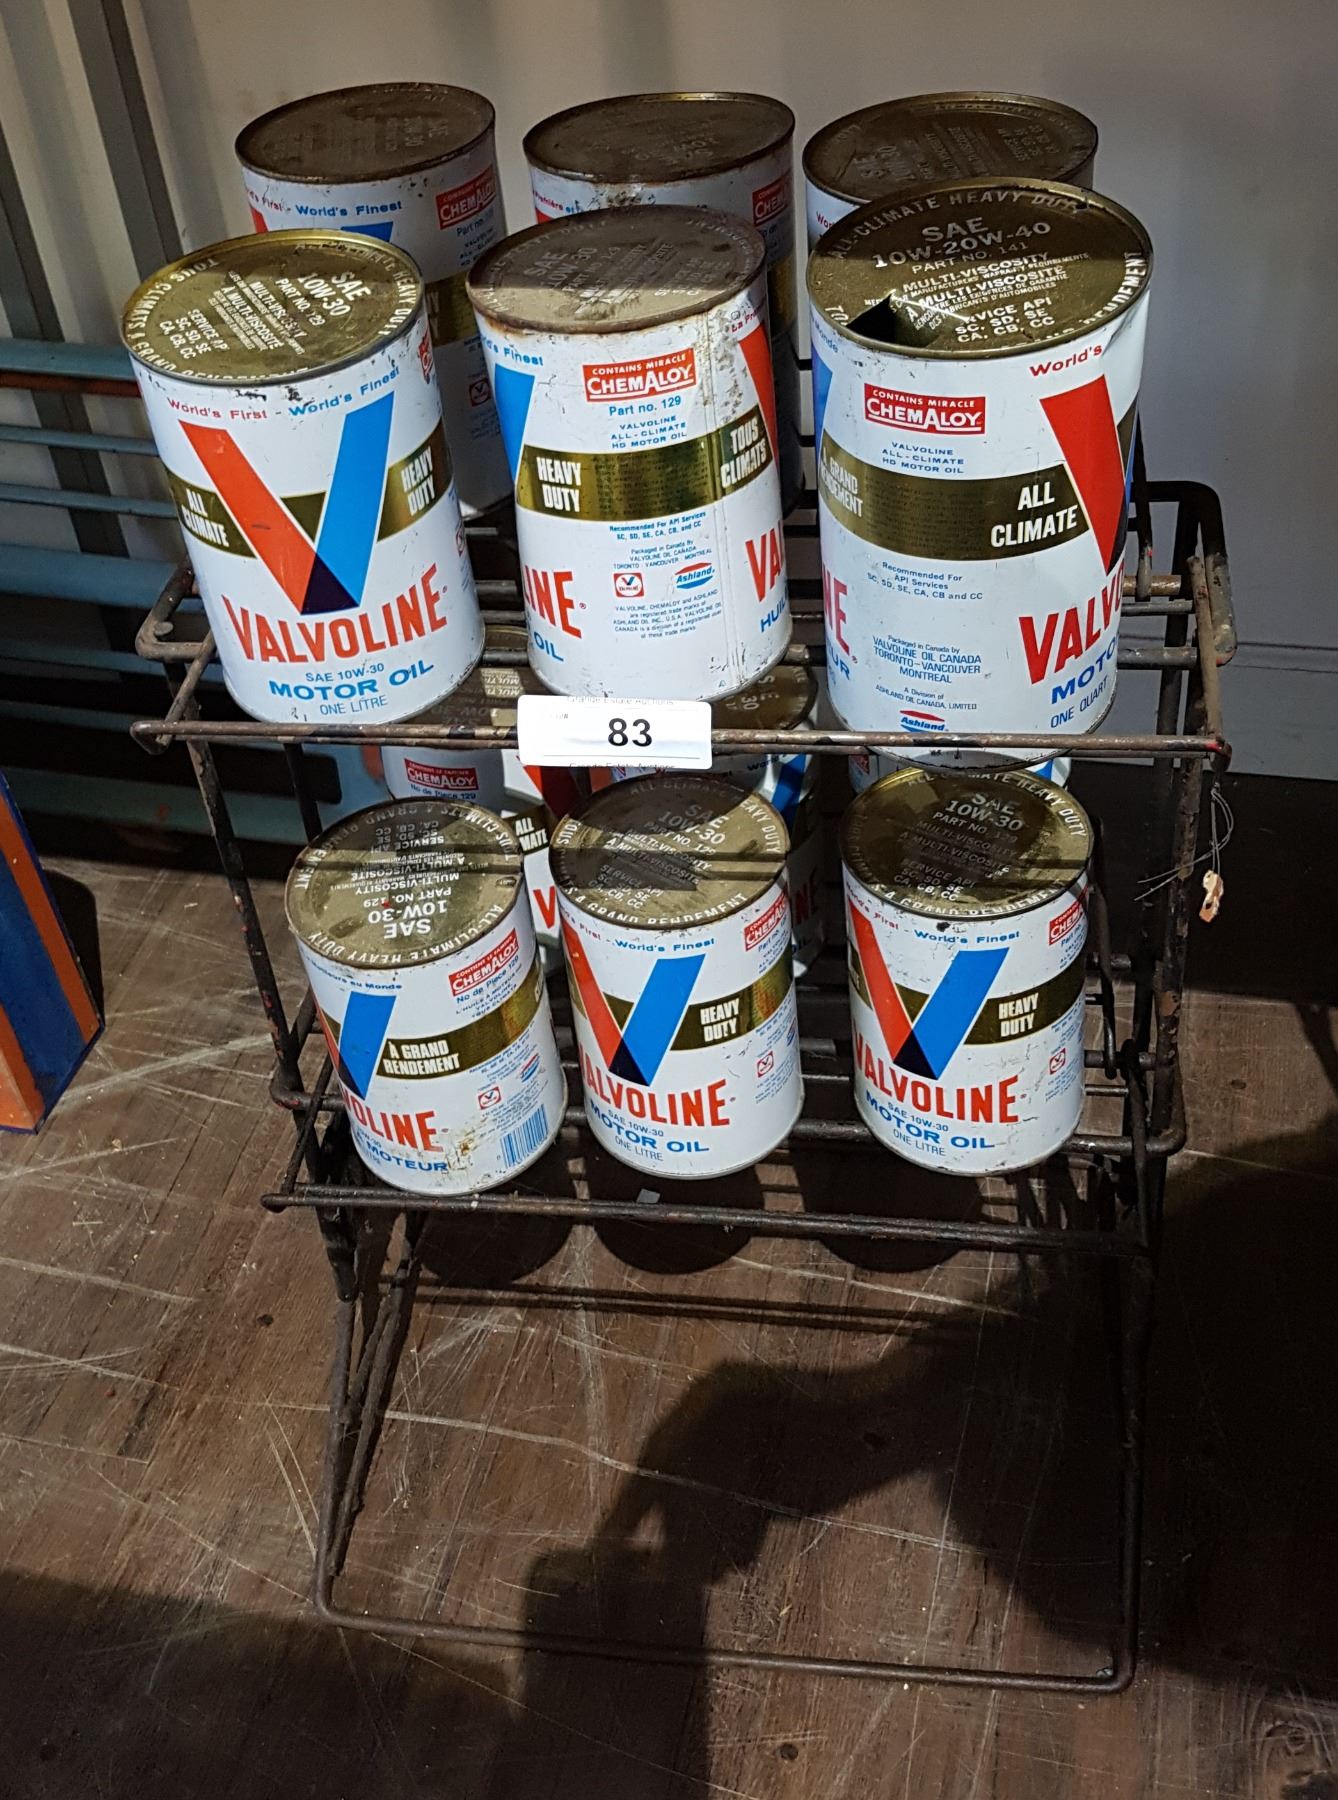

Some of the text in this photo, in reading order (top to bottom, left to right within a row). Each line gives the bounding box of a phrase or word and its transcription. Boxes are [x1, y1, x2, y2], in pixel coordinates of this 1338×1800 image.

[295, 201, 403, 217] World's Finest
[950, 189, 1022, 206] HEAVY
[921, 216, 989, 243] SAE
[871, 221, 1051, 269] 10W-20W-40
[911, 241, 1029, 274] PART NO. 141
[902, 251, 1048, 293] MULTI-VISCOSITY
[275, 278, 301, 299] PART
[297, 272, 351, 316] 10W-30
[331, 271, 371, 301] SAE
[1023, 296, 1052, 311] API
[1024, 307, 1048, 320] SE
[1029, 316, 1056, 328] CC
[504, 347, 544, 367] Finest
[592, 353, 687, 376] CONTAINS MIRACLE
[1029, 343, 1103, 378] World's
[586, 364, 693, 394] CHEMALOY
[167, 366, 400, 421] World's First World's Finest
[609, 395, 682, 416] Part no. 129
[873, 389, 976, 408] CONTAINS MIRACLE
[619, 415, 677, 430] VALVOLINE
[866, 399, 983, 431] CHEMALOY
[612, 431, 688, 449] HD MOTOR OIL
[730, 415, 759, 454] TOUS
[891, 441, 954, 455] VALVOLINE
[400, 446, 434, 493] HEAVY
[536, 456, 582, 486] HEAVY
[720, 441, 768, 490] CLIMATS
[882, 457, 965, 475] HD MOTOR OIL
[186, 488, 209, 518] ALL
[407, 473, 436, 517] DUTY
[542, 484, 580, 513] DUTY
[1017, 481, 1056, 511] ALL
[181, 505, 230, 548] CLIMATE
[609, 511, 707, 532] Recommended Services
[990, 504, 1079, 548] CLIMATE
[676, 565, 713, 584] Ashland
[882, 561, 964, 583] Recommended For
[894, 574, 950, 590] API Services
[932, 591, 984, 601] CB and CC
[221, 563, 448, 664] VALVOLINE
[534, 631, 564, 661] OIL
[872, 636, 982, 665] VALVOLINE OIL CANADA
[888, 634, 950, 653] Packaged Canada
[269, 659, 434, 702] MOTOR OIL
[305, 662, 385, 683] SAE 10W-30
[899, 666, 953, 685] MONTREAL
[320, 694, 389, 716] ONE LITRE
[875, 683, 905, 702] ASHLAND
[948, 701, 978, 711] LIMITED
[910, 688, 937, 699] Division
[1050, 676, 1109, 729] ONE QUART
[607, 717, 653, 748] 83
[900, 715, 946, 732] Ashland
[684, 804, 730, 829] SAE
[932, 811, 967, 830] PART
[944, 800, 1025, 832] 10W-30
[1016, 779, 1087, 837] HEAVY DUTY
[515, 817, 535, 836] ALL
[658, 810, 727, 846] 10W-30
[760, 824, 785, 854] DUTY
[395, 835, 445, 851] SERVICE
[671, 833, 692, 847] NO.
[355, 871, 460, 896] MULTI-VISCOSITY
[946, 883, 964, 895] SE
[954, 876, 977, 889] API
[363, 887, 452, 908] PART NO. 129
[626, 896, 645, 909] CC
[941, 890, 959, 903] CC
[368, 899, 448, 925] 10W-30
[383, 917, 431, 940] SAE
[914, 929, 969, 944] World's
[976, 930, 1020, 944] Finest
[614, 937, 716, 953] World's Finest
[452, 938, 518, 992] CHEMALOY
[364, 982, 403, 990] Monde
[456, 986, 483, 1004] No de
[700, 997, 741, 1025] HEAVY
[998, 992, 1040, 1020] HEAVY
[703, 1017, 739, 1043] DUTY
[1000, 1013, 1035, 1038] DUTY
[389, 1039, 449, 1059] À GRAND
[382, 1053, 460, 1076] RENDEMENT
[590, 1097, 710, 1153] MOTOR OIL
[607, 1109, 665, 1138] SAE 10W-30
[866, 1090, 995, 1149] MOTOR OIL
[888, 1101, 949, 1132] SAE 10W-30
[614, 1135, 664, 1162] ONE LITRE
[892, 1127, 946, 1157] ONE LITRE
[366, 1140, 449, 1172] MOTEUR
